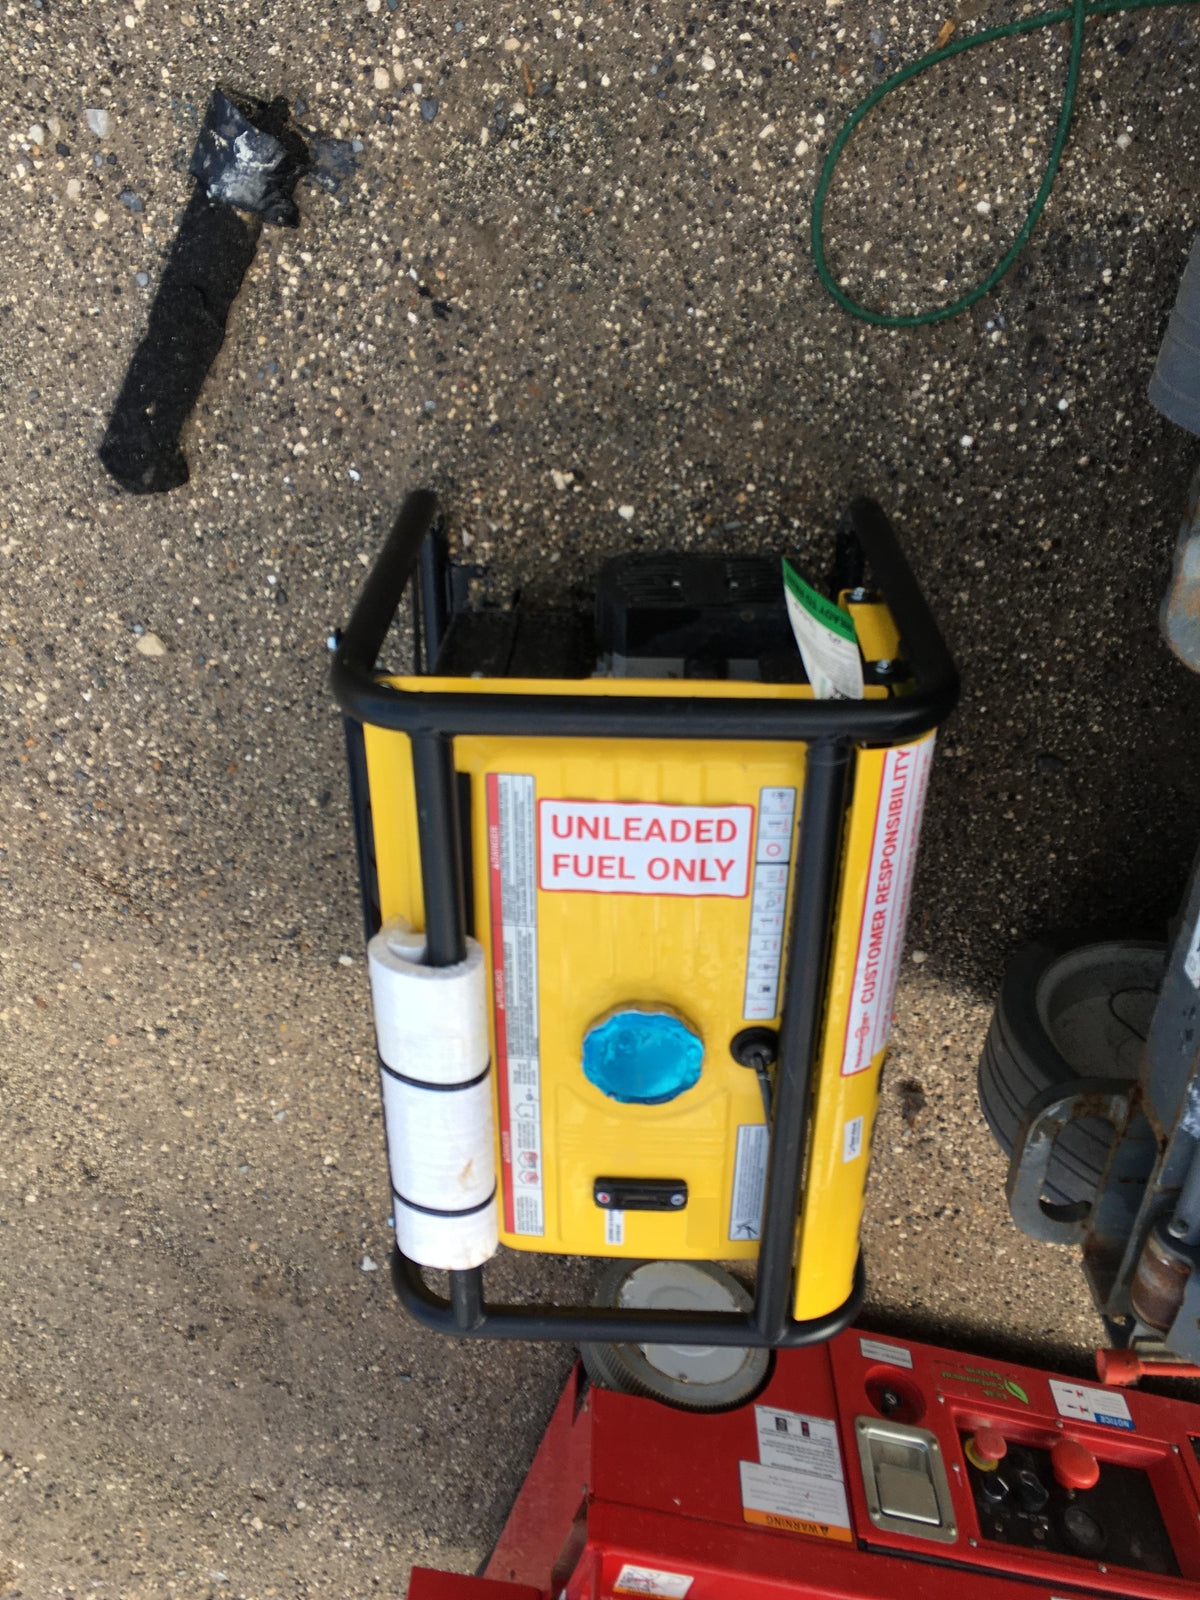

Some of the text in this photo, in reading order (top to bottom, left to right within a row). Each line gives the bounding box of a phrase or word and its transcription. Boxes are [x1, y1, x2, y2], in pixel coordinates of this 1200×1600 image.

[551, 814, 737, 844] UNLEADED
[489, 825, 500, 864] DANGER
[552, 853, 736, 882] FUEL ONLY
[859, 750, 912, 1005] CUSTOMER RESPONSIBILITY
[1100, 1415, 1131, 1429] NOTICE
[765, 1515, 819, 1535] WARNING
